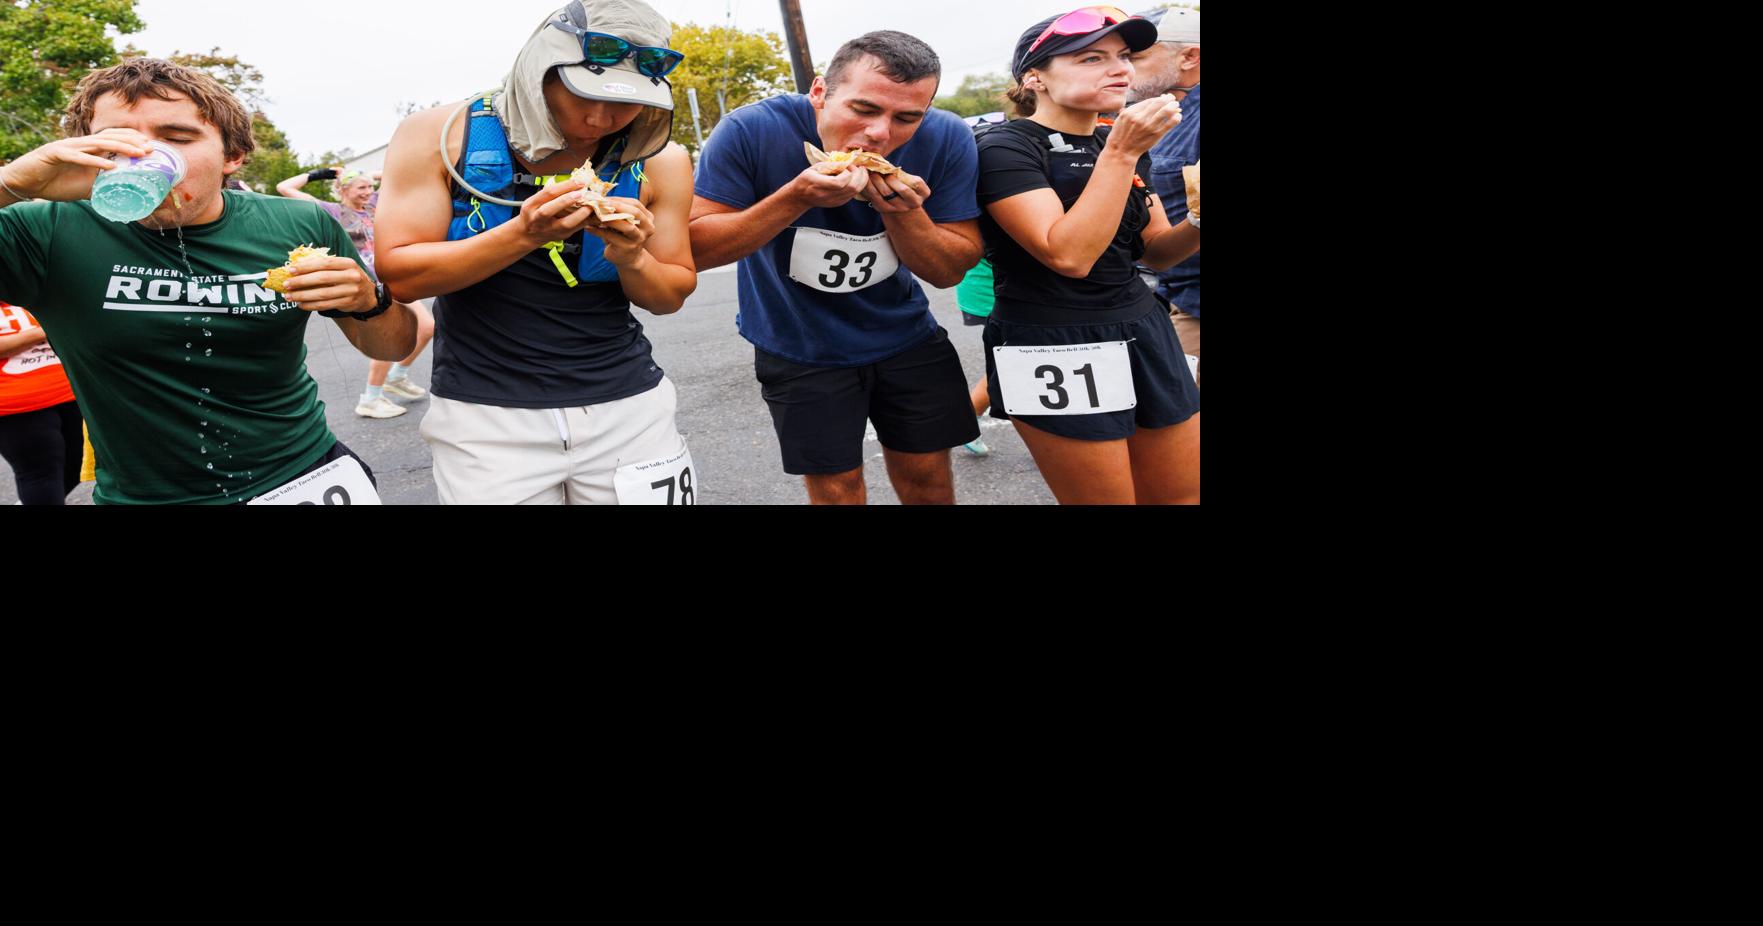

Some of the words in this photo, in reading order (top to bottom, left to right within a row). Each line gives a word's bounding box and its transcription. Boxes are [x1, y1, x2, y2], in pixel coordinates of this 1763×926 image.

[191, 275, 224, 284] STATE
[818, 249, 877, 288] 33
[105, 275, 286, 305] ROWIN
[232, 305, 268, 315] SPORT
[280, 301, 299, 311] CLU
[1034, 363, 1100, 410] 31
[280, 483, 298, 496] Valley
[650, 466, 695, 505] 78
